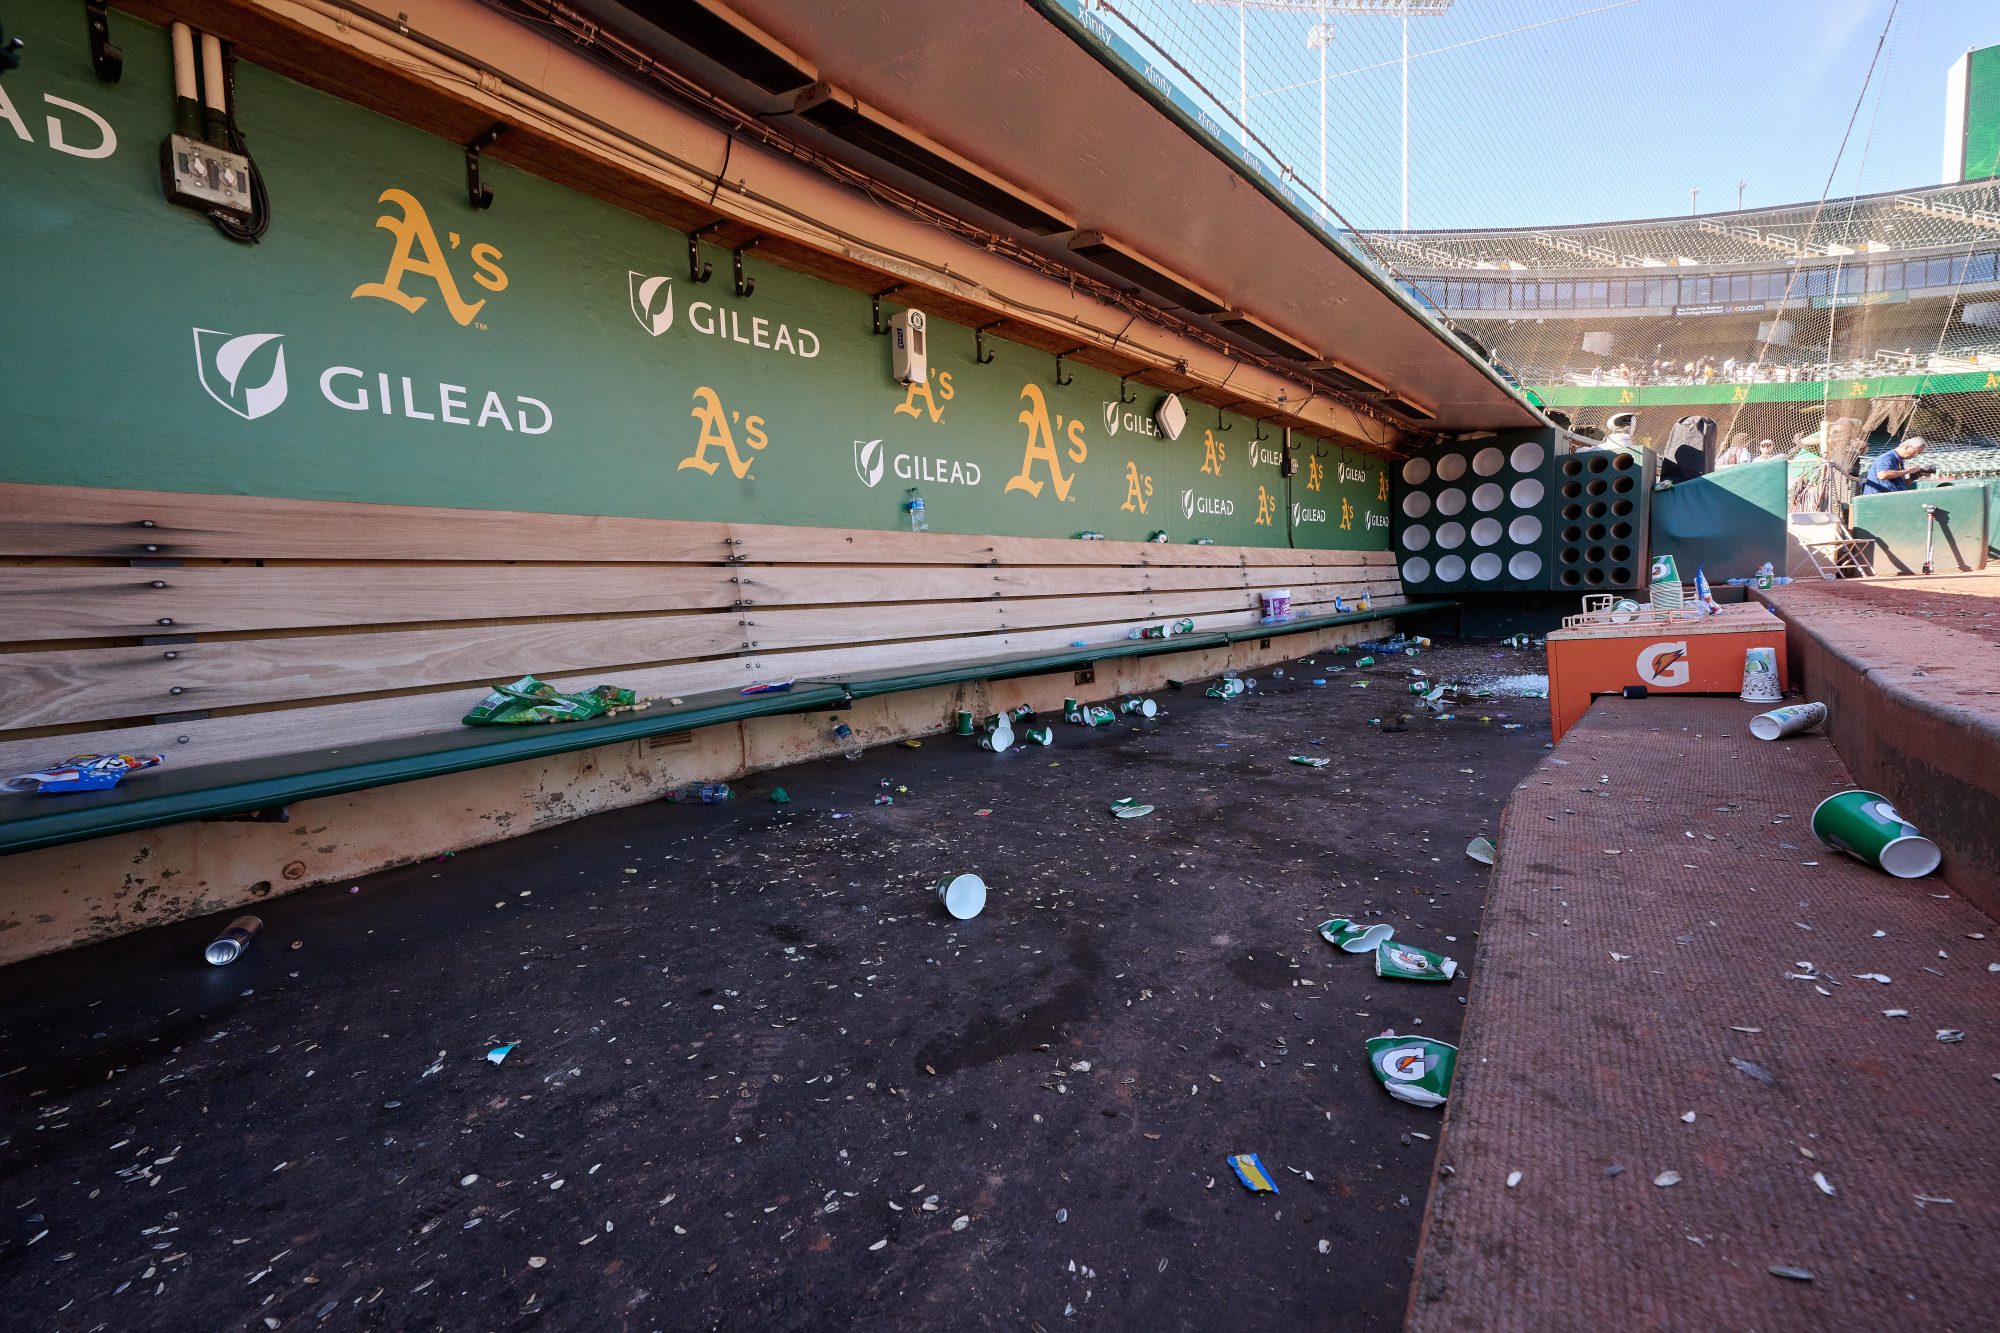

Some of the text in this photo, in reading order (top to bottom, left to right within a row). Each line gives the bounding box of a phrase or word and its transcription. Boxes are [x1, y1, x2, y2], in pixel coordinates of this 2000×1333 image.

[351, 188, 509, 326] A's
[688, 301, 820, 358] GILEAD
[319, 365, 553, 435] GILEAD
[679, 386, 769, 480] A's
[1005, 383, 1088, 502] A's
[1123, 412, 1162, 438] GILEA
[893, 453, 981, 486] GILEAD
[1199, 428, 1226, 477] A's
[1120, 460, 1153, 513] A's
[1306, 454, 1324, 493] A's
[1345, 467, 1366, 483] GILEAD
[1196, 497, 1234, 516] GILEAD
[1255, 485, 1276, 527] A's
[1301, 508, 1326, 523] GILEAD
[1340, 497, 1354, 531] A's
[1371, 514, 1390, 527] GILEAD
[1636, 640, 1690, 687] G
[1381, 1046, 1425, 1081] G
